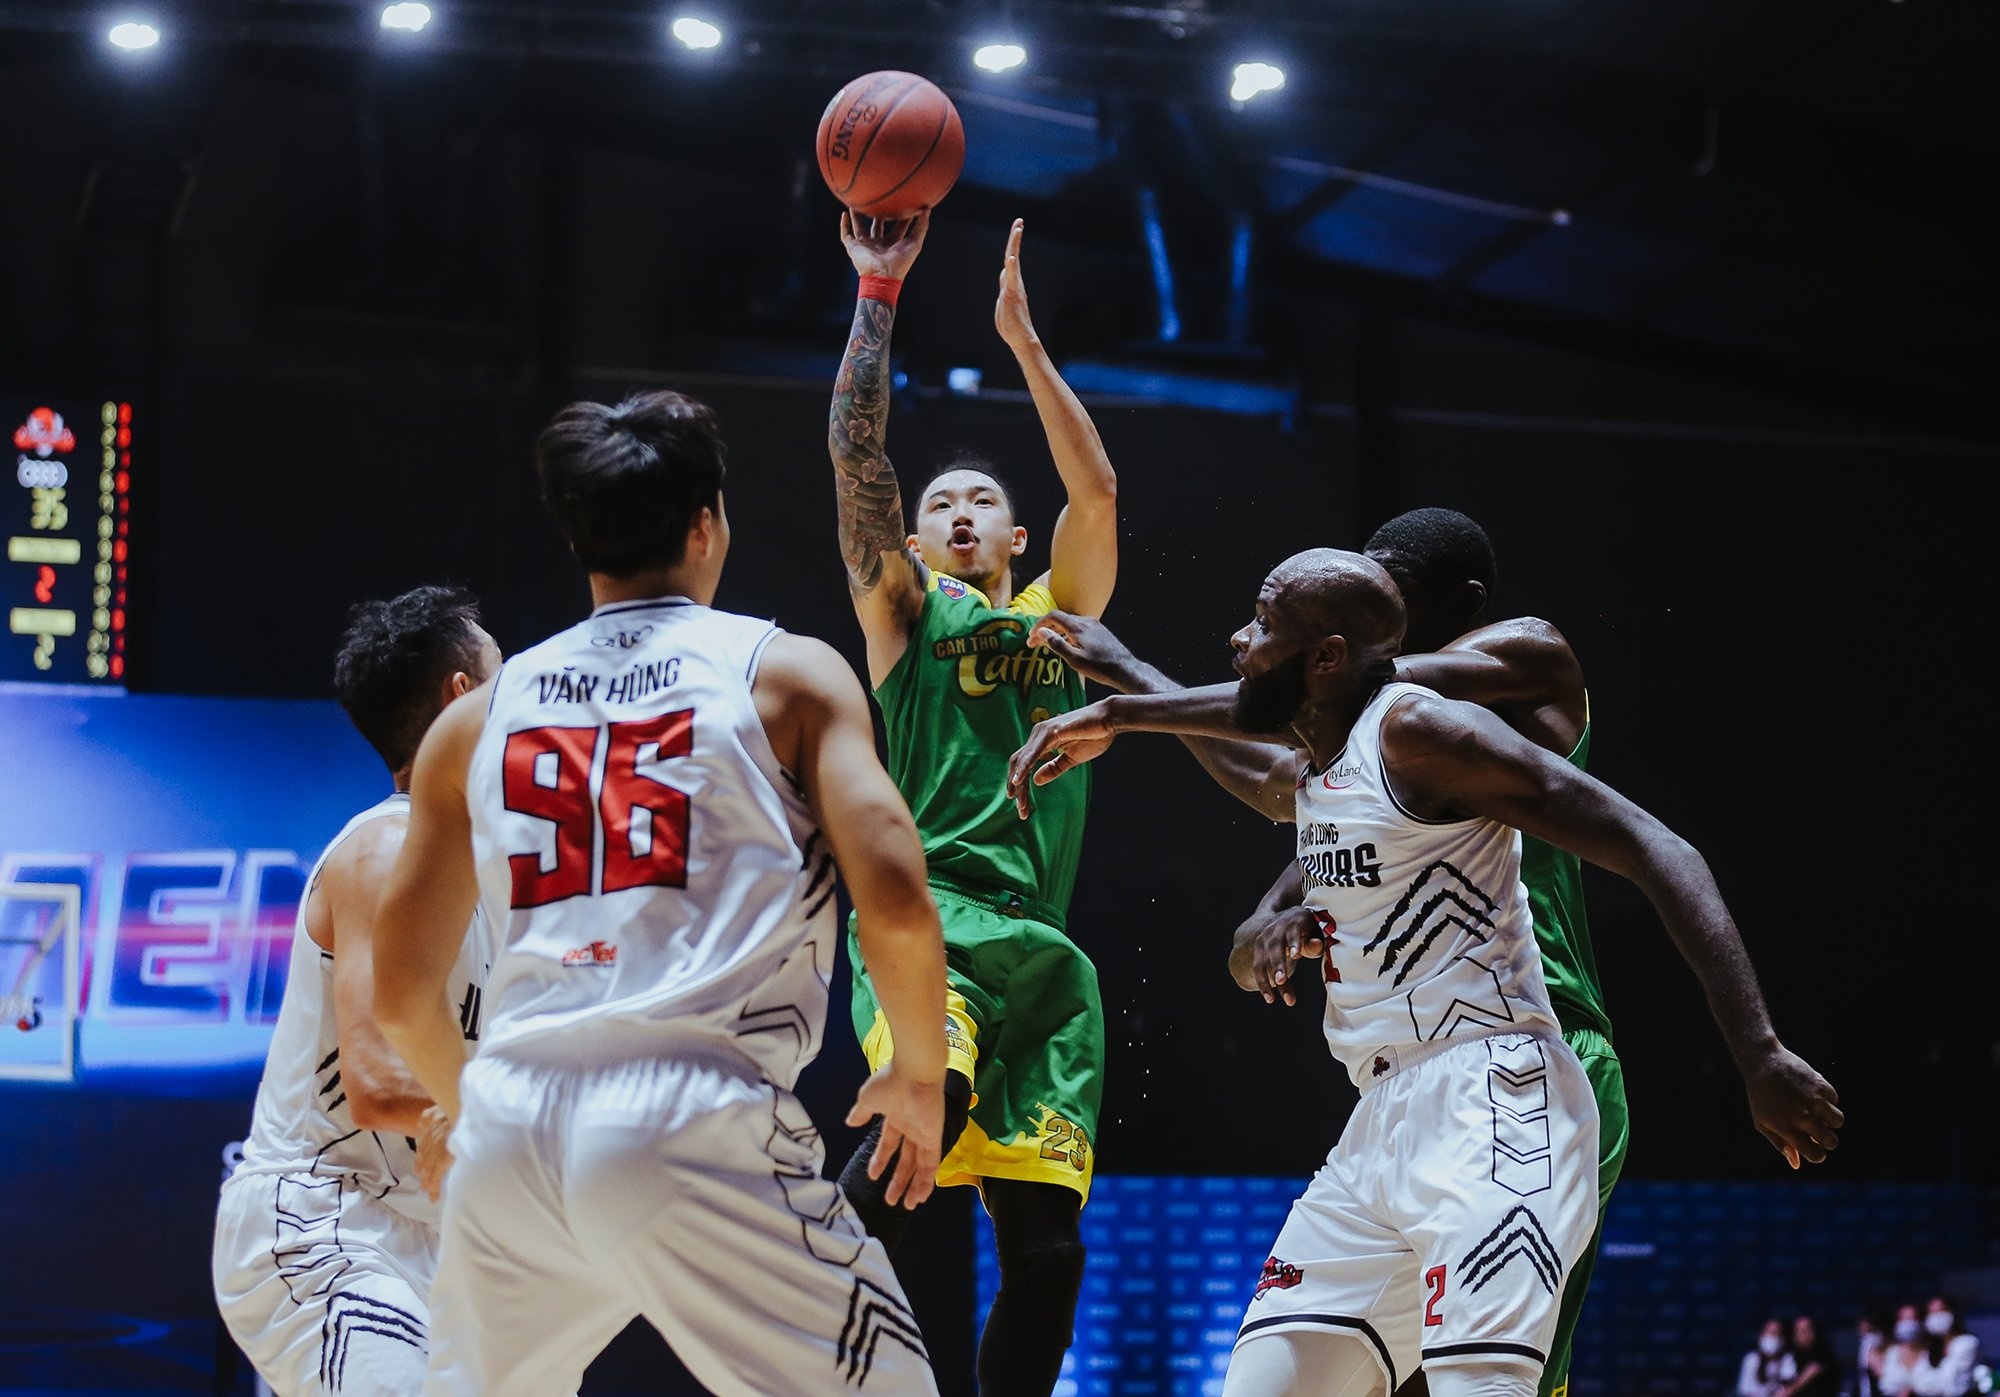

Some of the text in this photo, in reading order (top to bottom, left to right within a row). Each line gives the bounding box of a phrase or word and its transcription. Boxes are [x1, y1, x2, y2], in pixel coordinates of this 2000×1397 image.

[539, 657, 681, 705] VĂN HÙNG
[502, 707, 695, 910] 96
[1039, 1115, 1089, 1172] 23
[1424, 1264, 1447, 1327] 2
